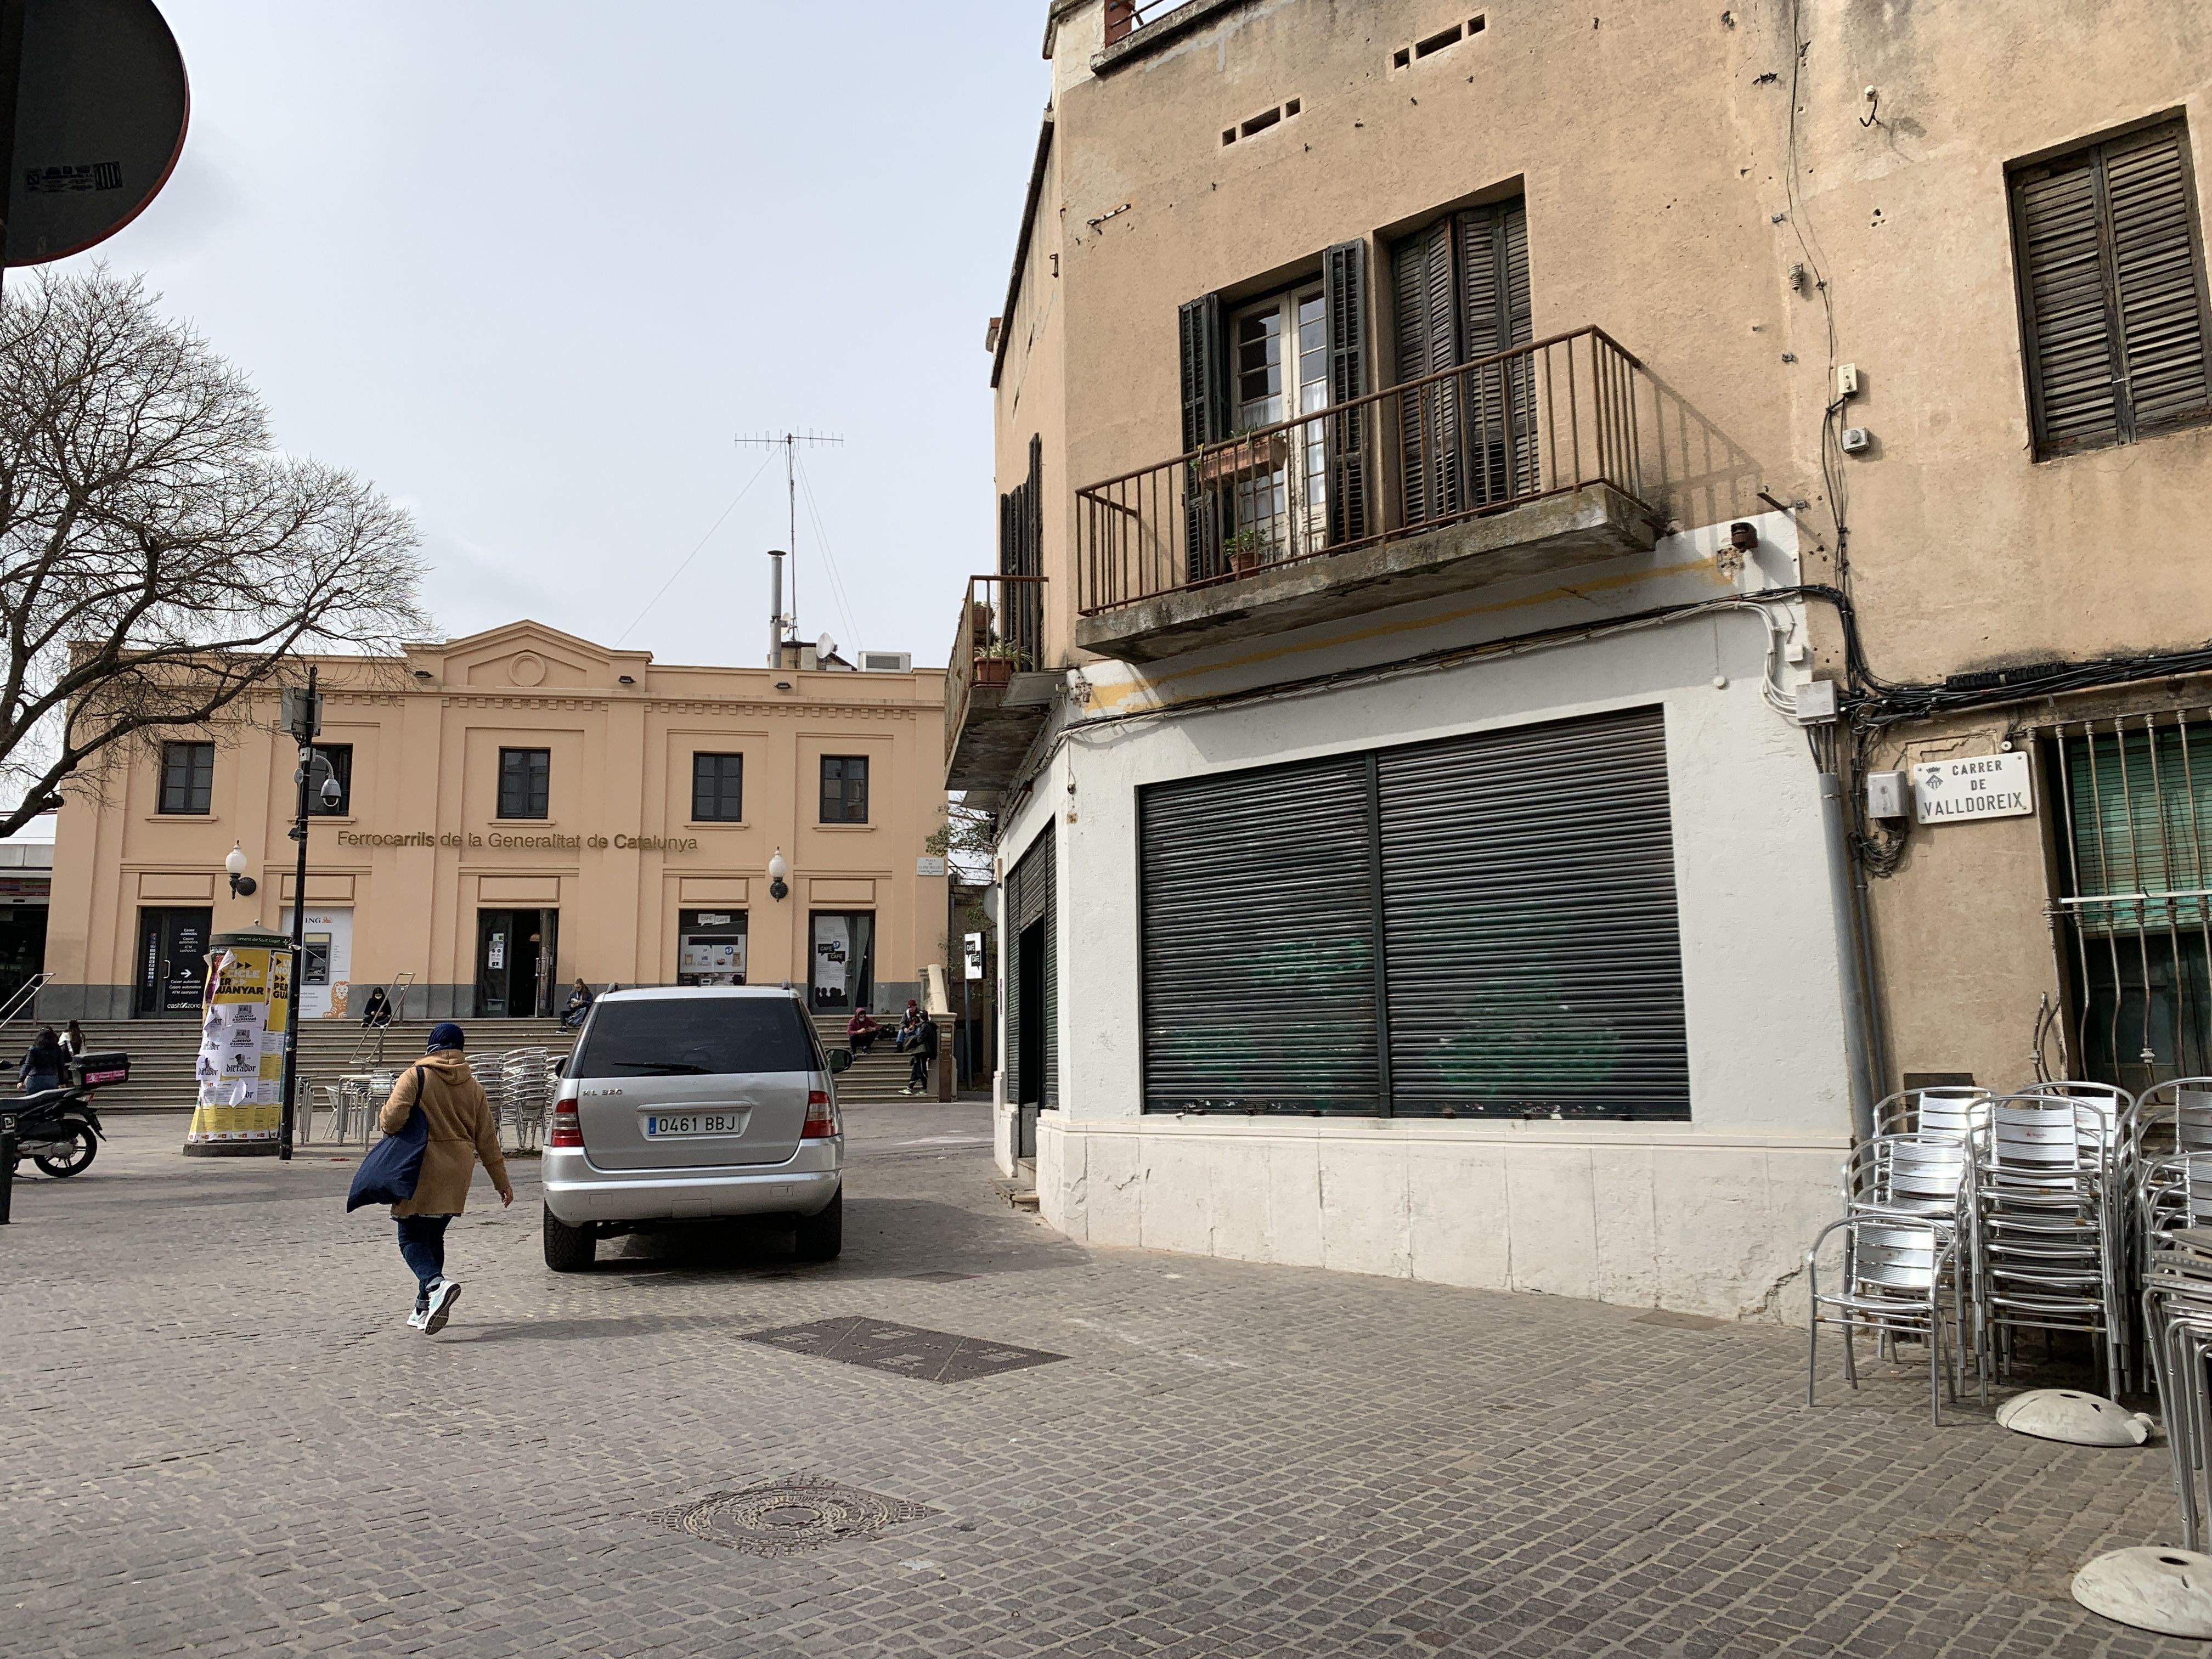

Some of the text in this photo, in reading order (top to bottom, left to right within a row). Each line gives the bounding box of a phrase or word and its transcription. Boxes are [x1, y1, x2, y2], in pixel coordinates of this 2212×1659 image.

[1953, 760, 2002, 775] CARRER
[1971, 778, 1987, 791] DE
[1925, 792, 2023, 816] VALLDOREIX
[337, 831, 698, 852] Ferrocarrils de la Generalitat de Catalunya
[220, 978, 232, 986] ER
[215, 986, 263, 995] UANYAR
[226, 1064, 256, 1073] dictador
[659, 1116, 735, 1132] 0461 BBJ
